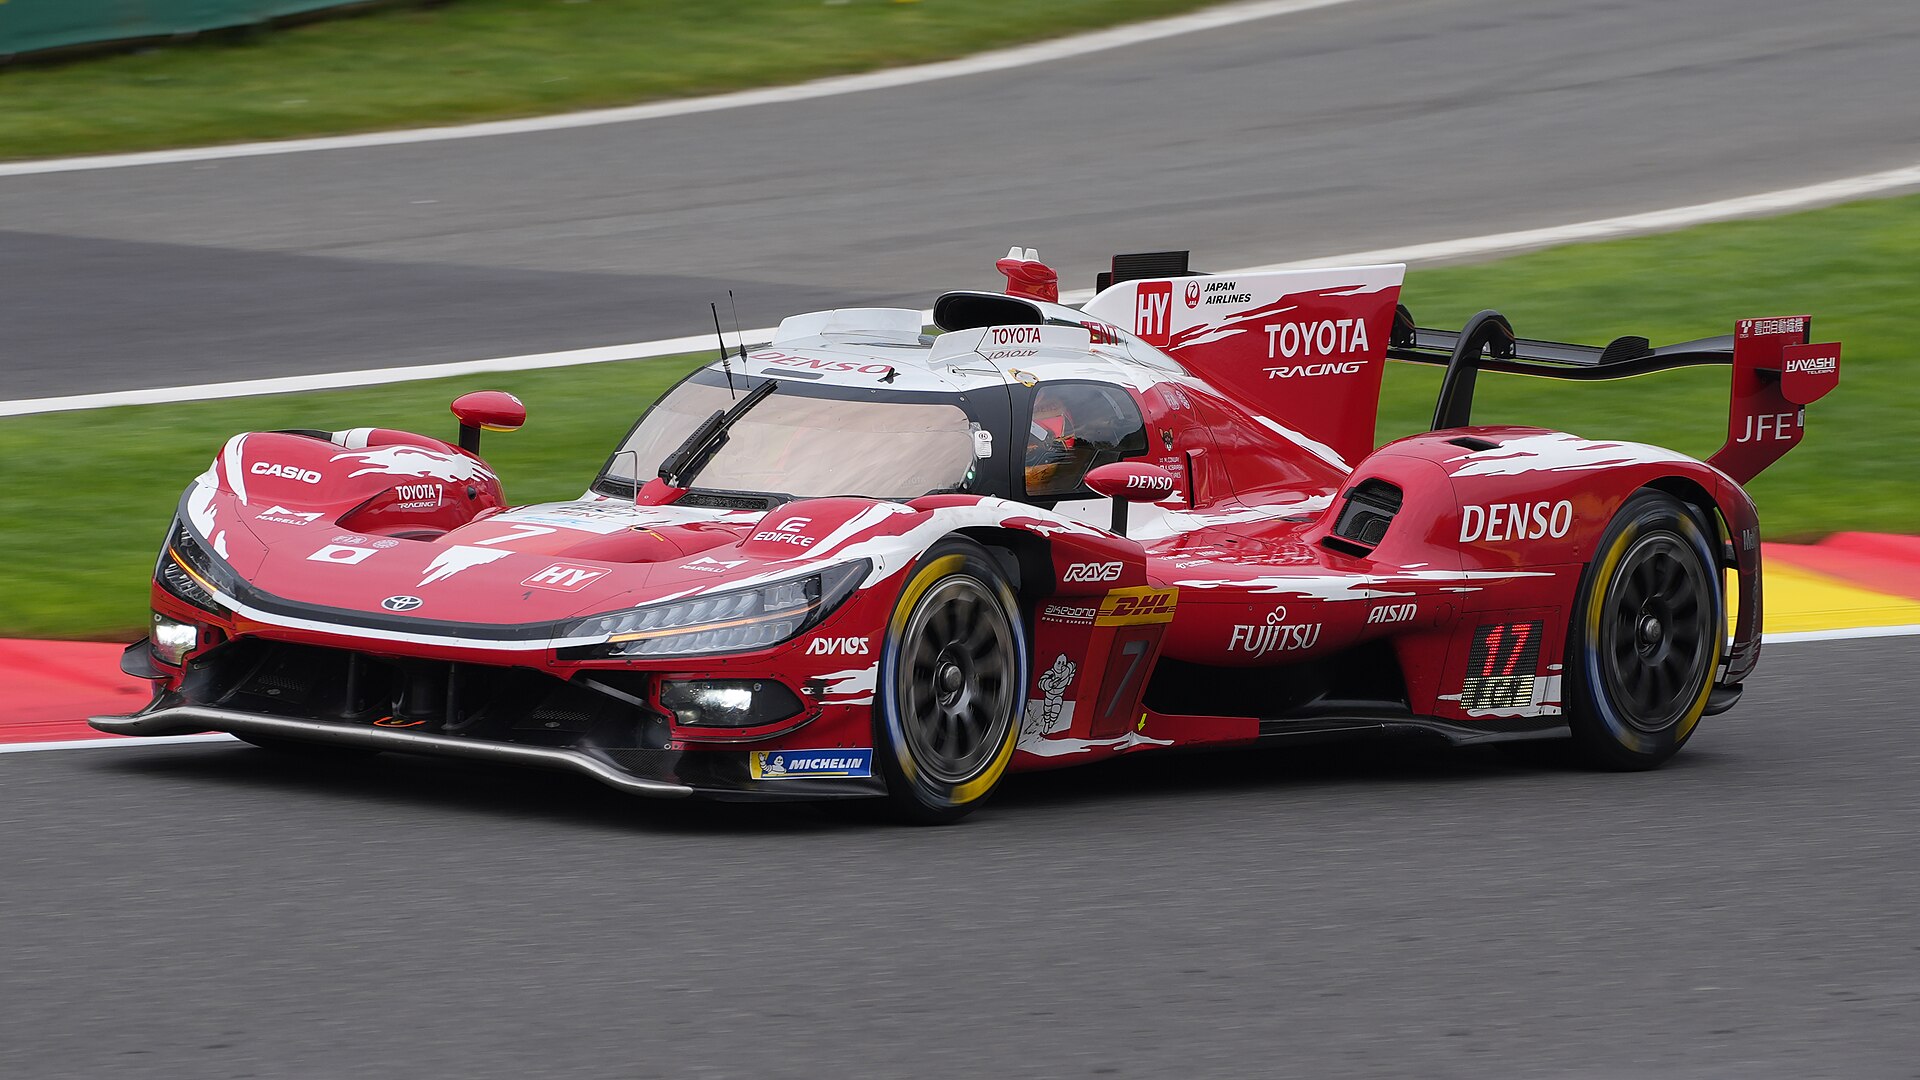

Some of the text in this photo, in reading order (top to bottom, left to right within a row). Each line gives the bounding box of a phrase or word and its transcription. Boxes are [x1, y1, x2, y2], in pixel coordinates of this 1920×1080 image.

[1204, 281, 1236, 292] JAPAN
[1205, 293, 1252, 305] AIRLINES
[1137, 292, 1170, 336] HY
[992, 327, 1041, 345] TOYOTA
[1264, 318, 1369, 358] TOYOTA
[749, 351, 894, 374] DENSO
[1262, 360, 1369, 379] RACING
[1785, 357, 1836, 373] HAYASHI
[1736, 412, 1793, 443] JFE
[250, 461, 322, 484] CASIO
[1126, 475, 1173, 490] DENSO
[395, 484, 443, 507] TOYOTA 7
[396, 501, 436, 509] RACING
[254, 515, 308, 526] MARELLI
[1459, 500, 1573, 543] DENSO
[474, 524, 558, 546] 7
[753, 531, 815, 547] EDIFICE
[531, 566, 602, 587] HY
[679, 564, 726, 573] MARELLI
[1063, 561, 1123, 583] RAYS
[1110, 593, 1171, 616] DHL
[1367, 603, 1418, 624] AISIN
[1227, 622, 1322, 659] FUJITSU
[1482, 623, 1533, 676] 17
[1104, 640, 1150, 718] 7
[789, 757, 863, 770] MICHELIN
